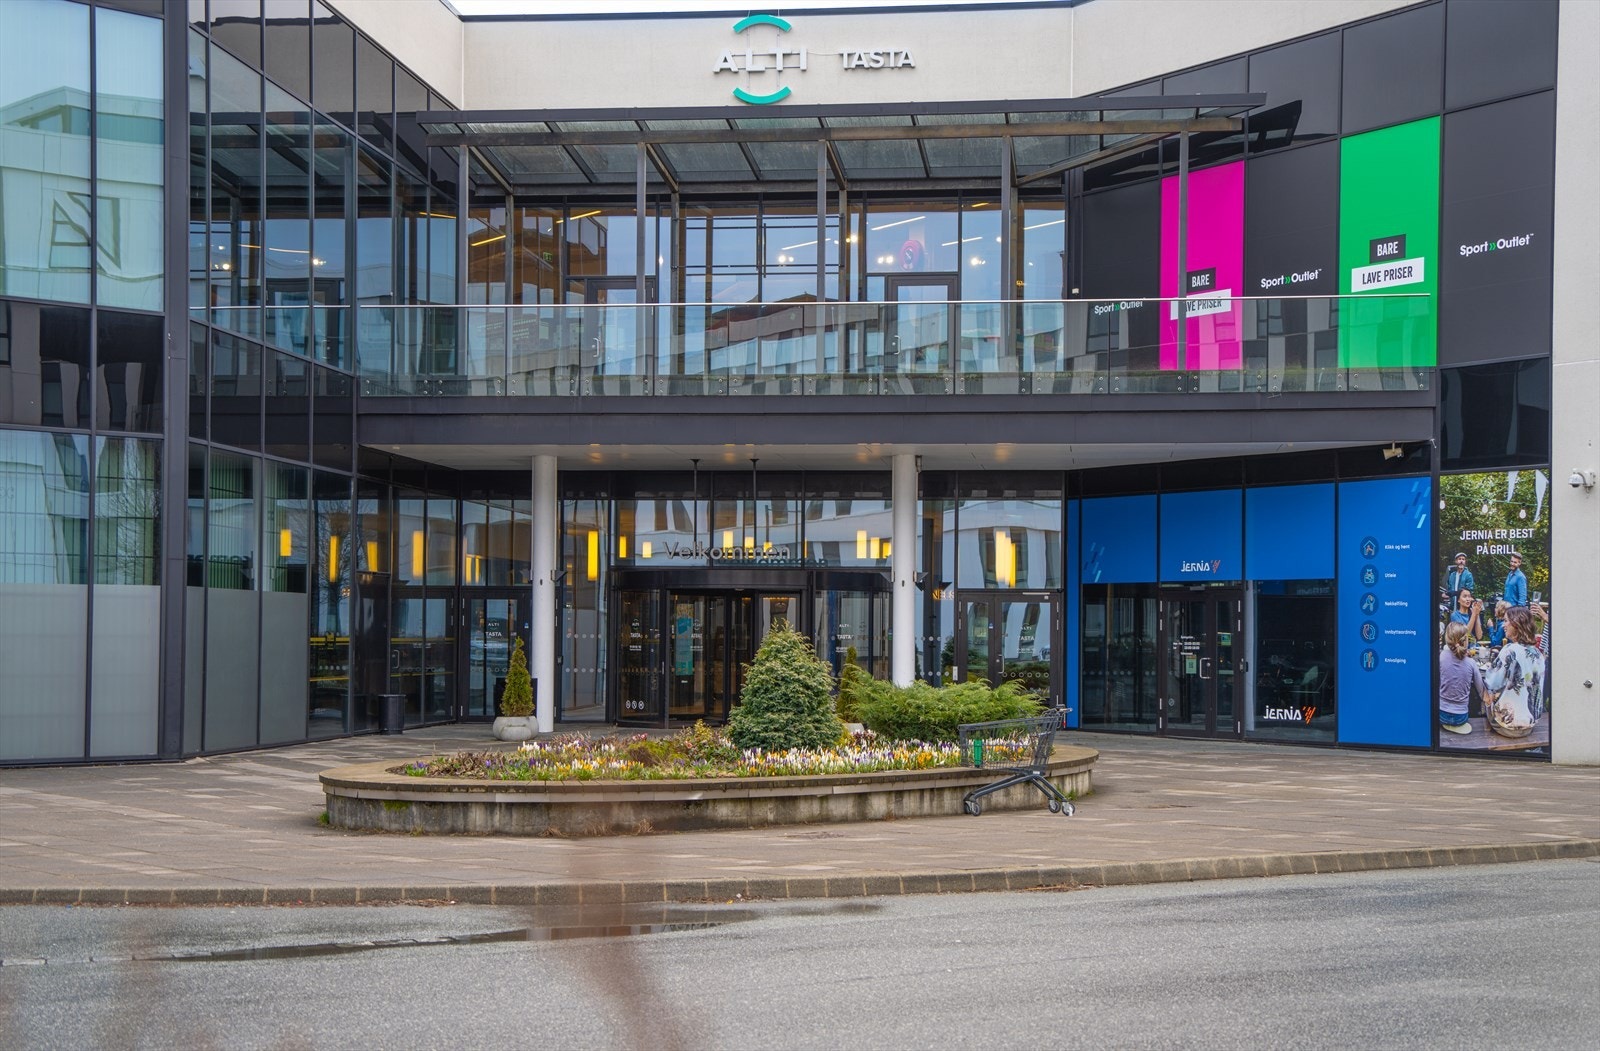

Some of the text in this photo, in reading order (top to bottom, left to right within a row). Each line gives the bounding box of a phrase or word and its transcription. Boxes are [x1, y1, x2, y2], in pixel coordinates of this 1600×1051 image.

[712, 47, 916, 73] ALTI TASTA
[1376, 241, 1399, 257] BARE
[1460, 234, 1530, 257] Sport Outlet
[1191, 273, 1210, 288] BARE
[1260, 270, 1320, 290] Sport Outlet
[1362, 265, 1413, 285] LAVE PRISER
[1094, 303, 1115, 316] Sport
[1459, 528, 1535, 541] JERNIA ER BEST
[663, 541, 791, 560] Velkommen
[1476, 542, 1517, 555] PÅ GRILL
